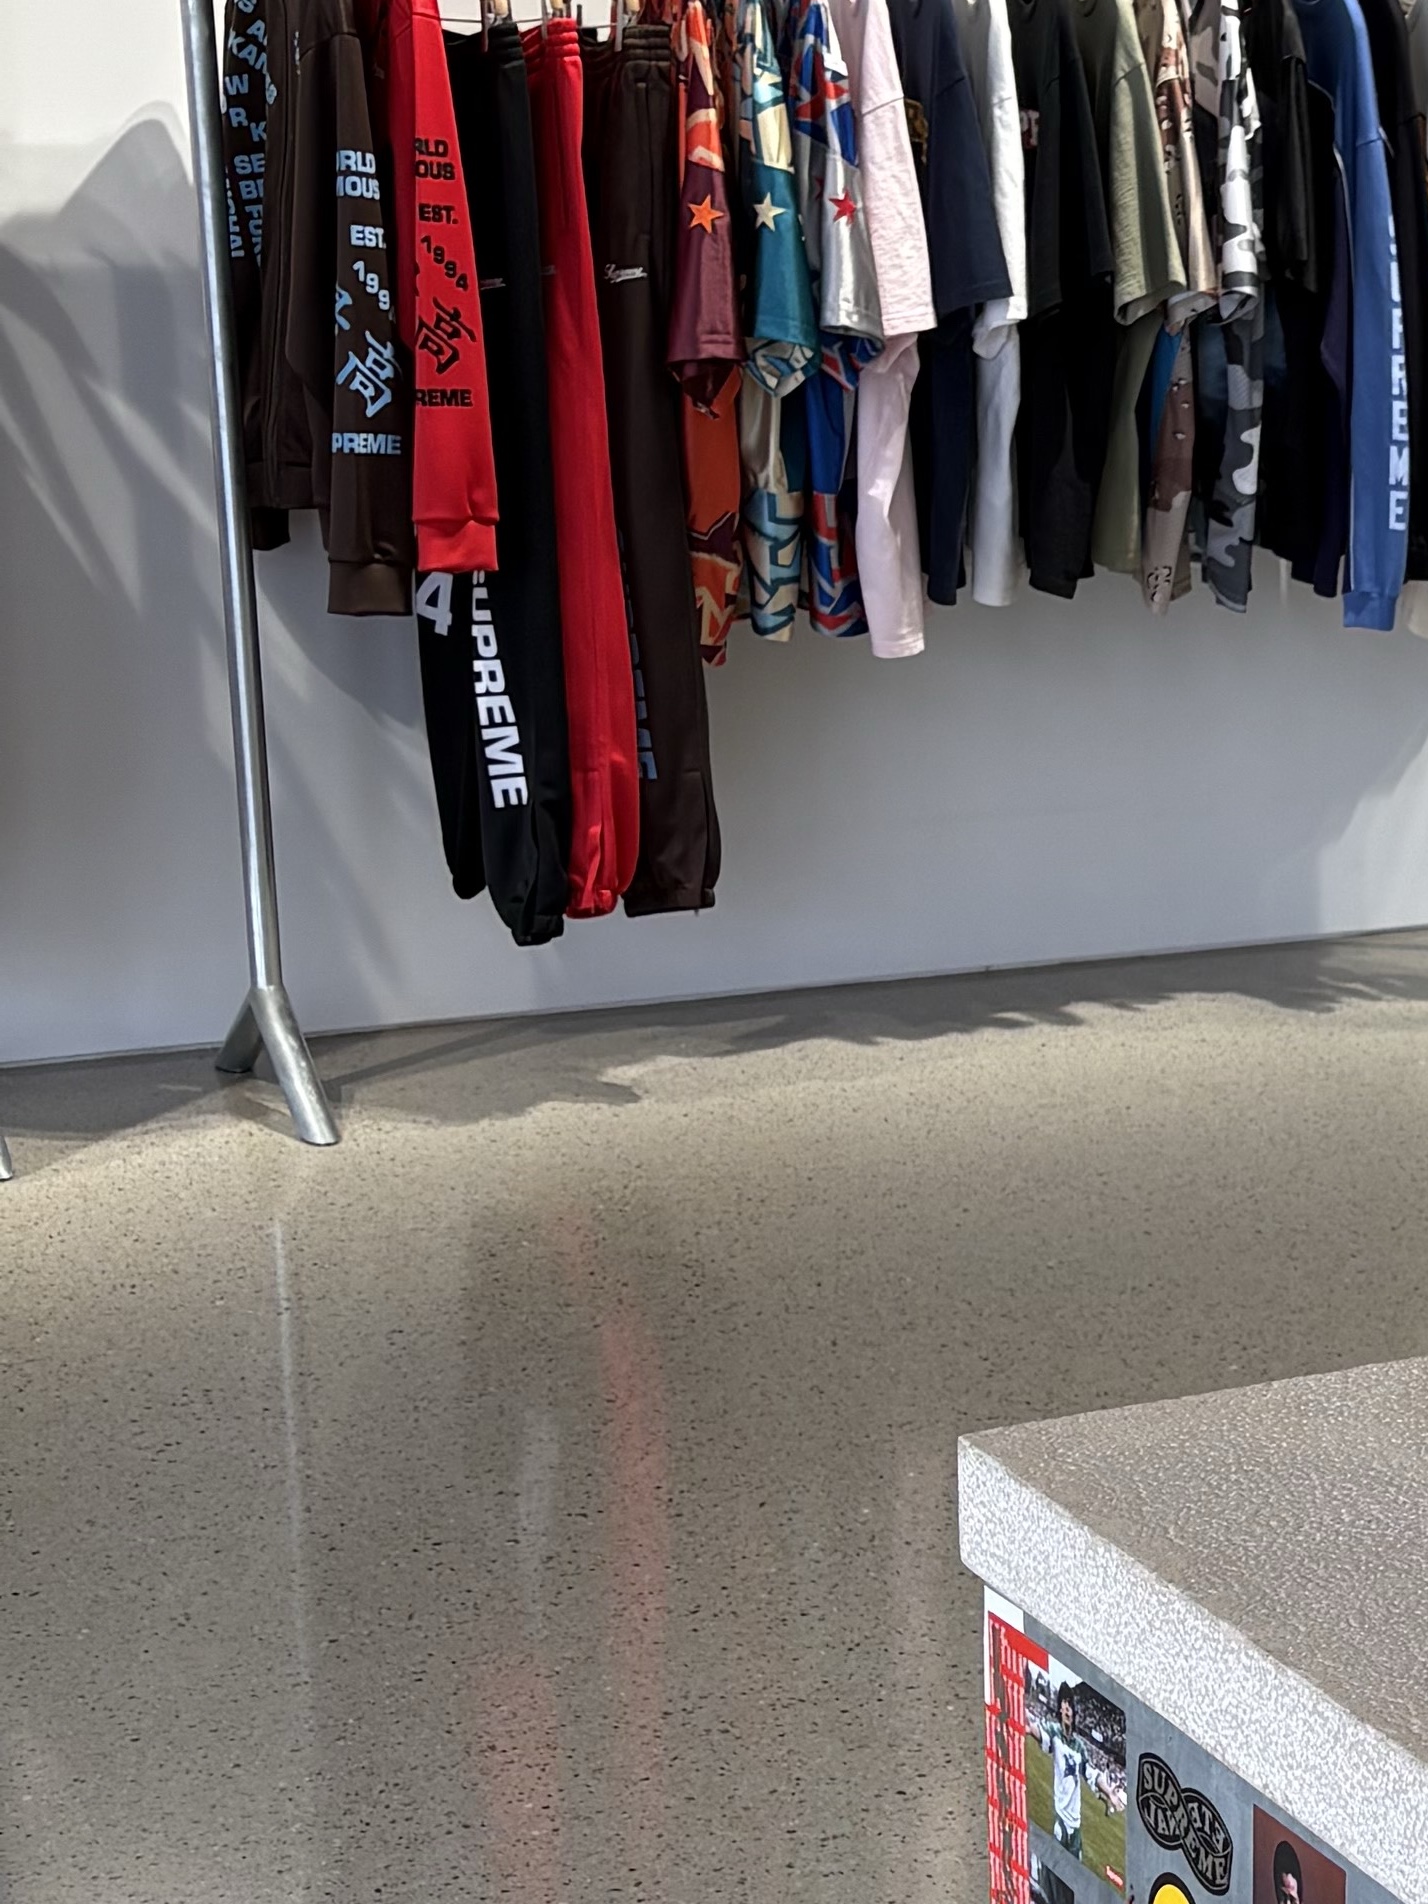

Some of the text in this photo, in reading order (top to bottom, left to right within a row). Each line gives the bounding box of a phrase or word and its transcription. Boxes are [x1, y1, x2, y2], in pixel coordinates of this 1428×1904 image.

[418, 203, 459, 224] EST.
[415, 389, 473, 407] REME
[331, 432, 401, 455] PREME
[471, 570, 529, 809] UPREME
